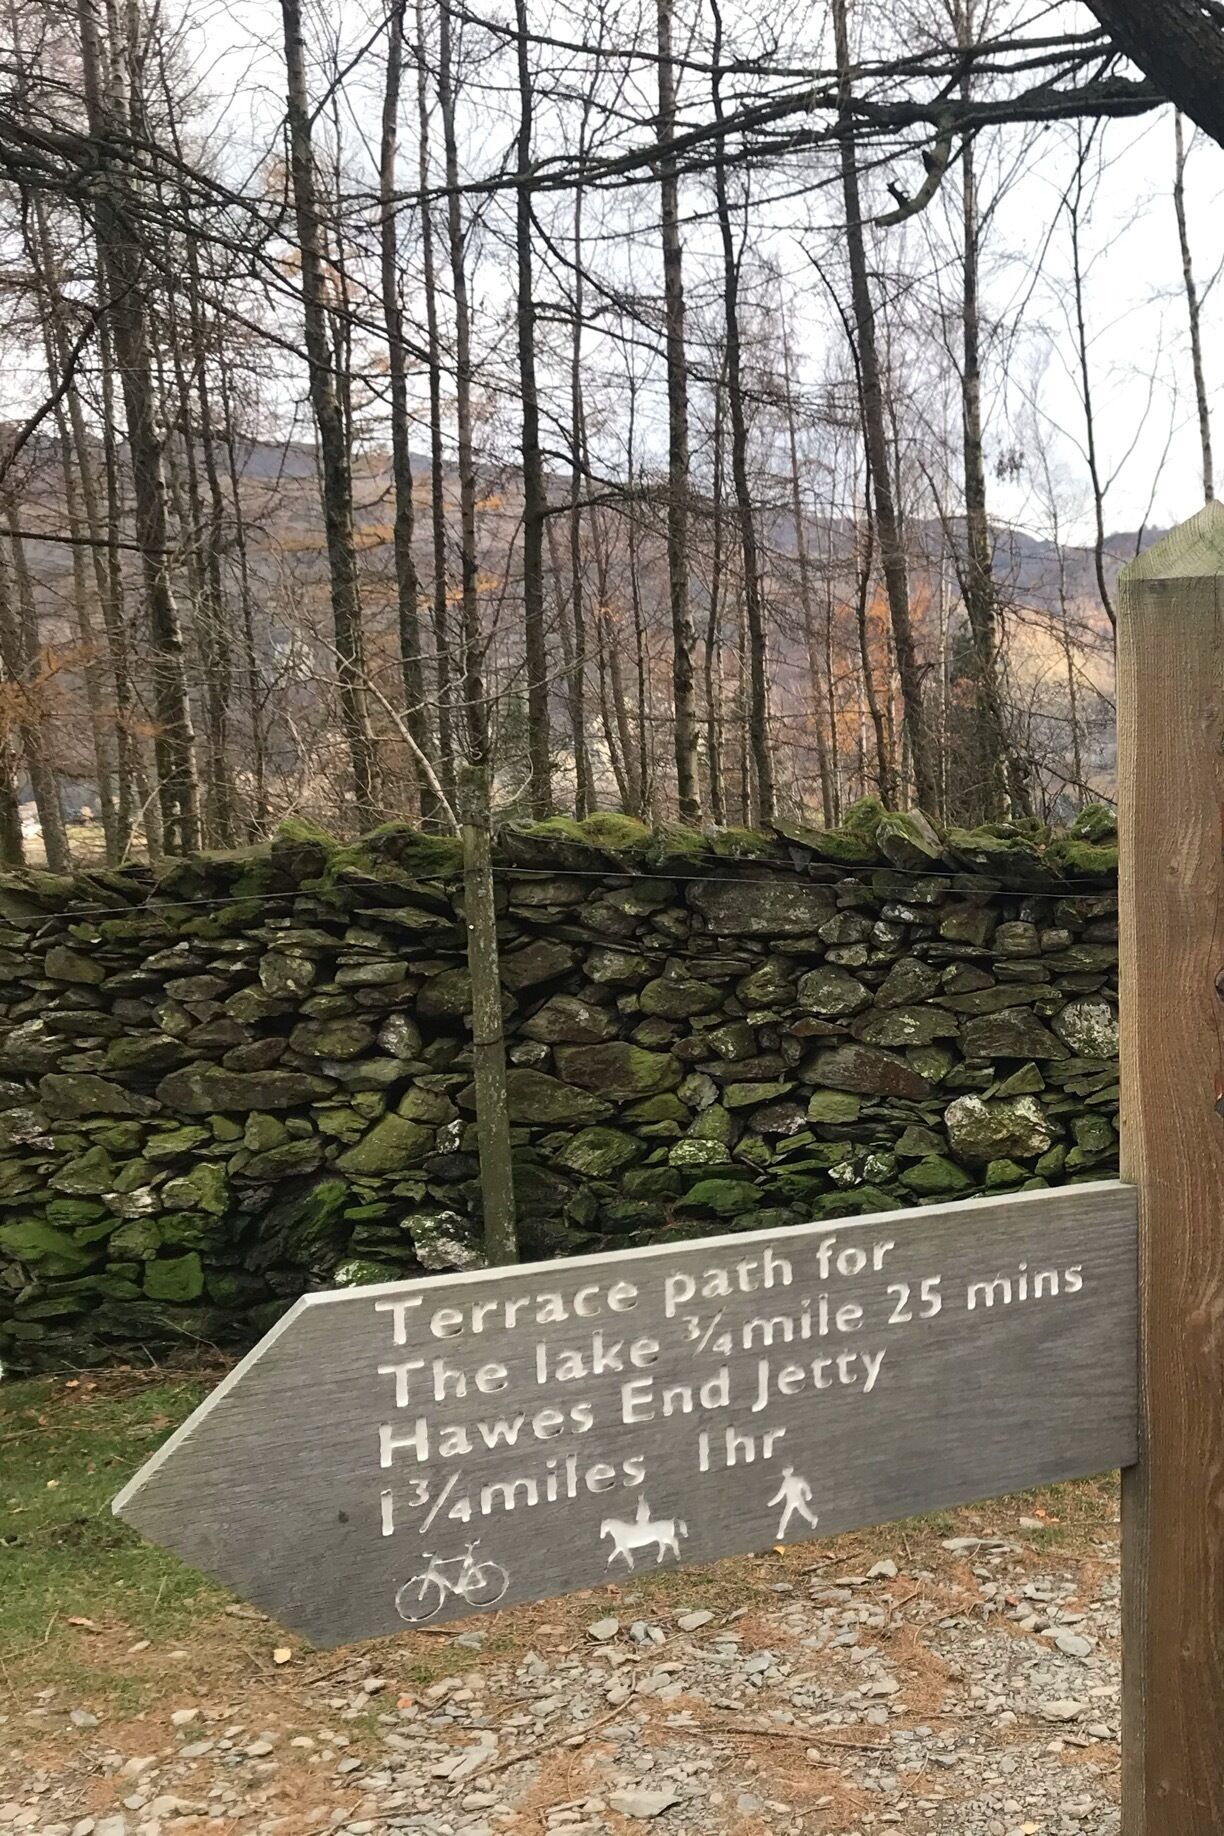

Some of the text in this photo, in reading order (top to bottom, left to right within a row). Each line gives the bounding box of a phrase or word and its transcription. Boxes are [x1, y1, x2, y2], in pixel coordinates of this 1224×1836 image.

[374, 1237, 895, 1346] Terrace path for
[377, 1360, 508, 1408] The
[536, 1330, 660, 1384] lake
[887, 1275, 942, 1324] 25
[967, 1262, 1083, 1311] mins
[379, 1347, 886, 1468] Hawes End Jetty
